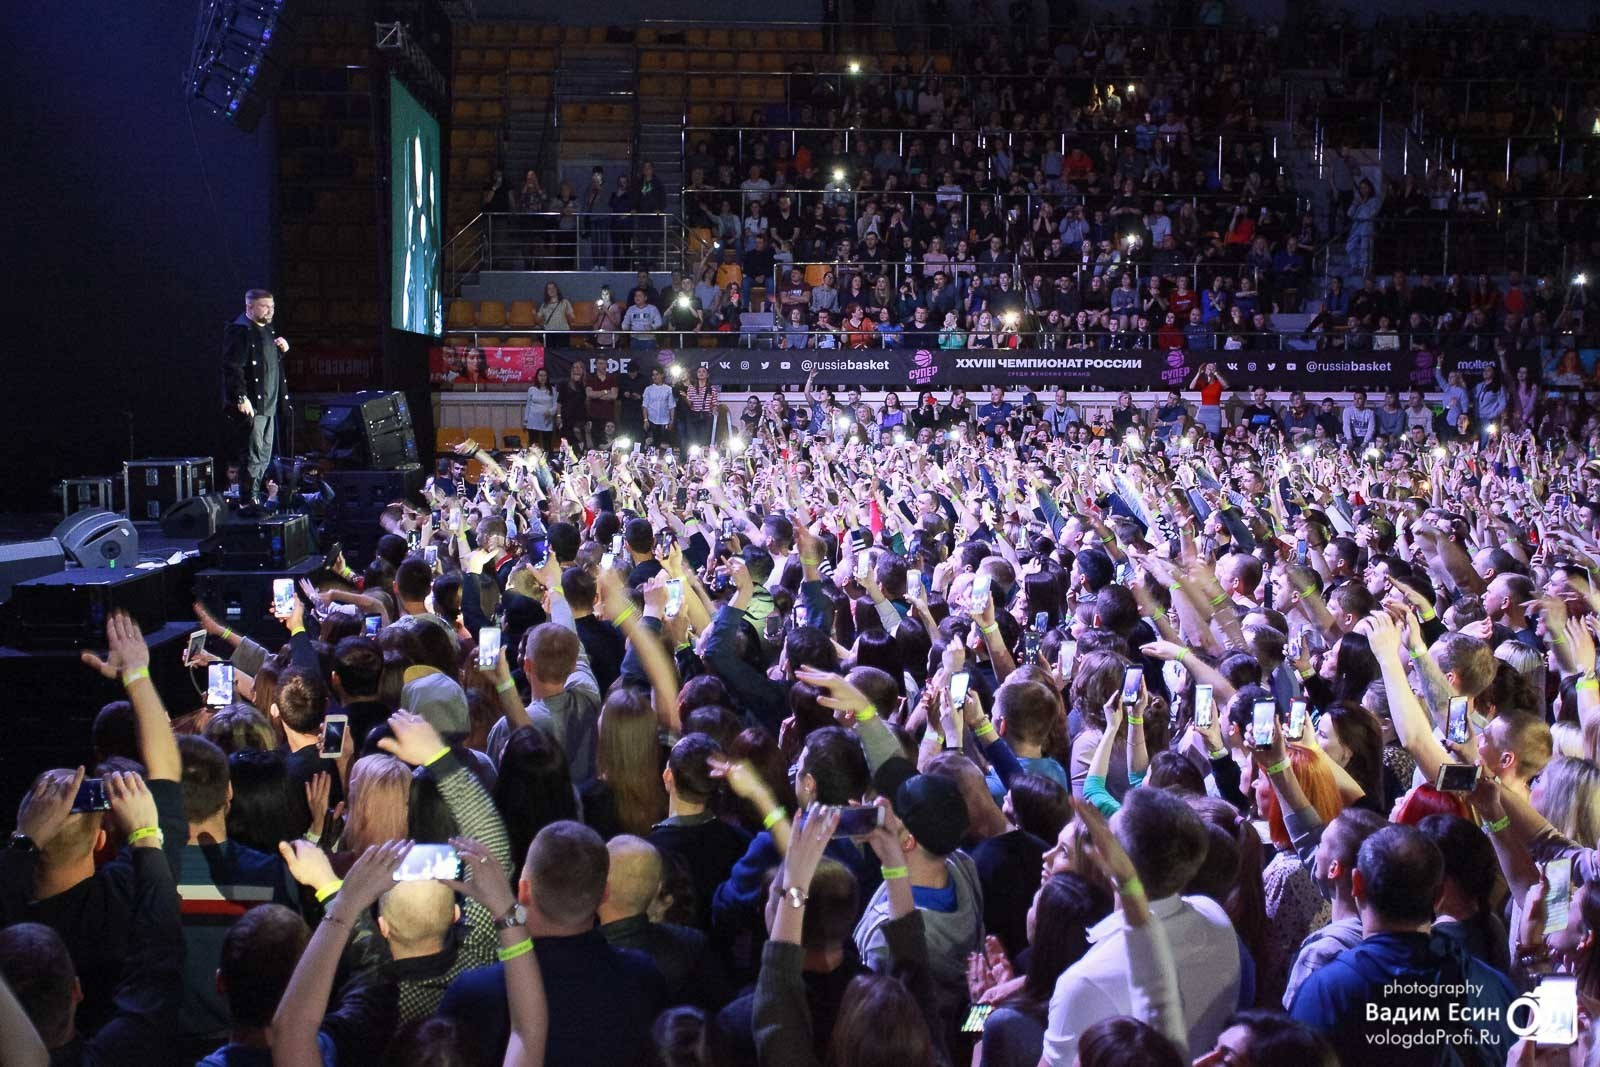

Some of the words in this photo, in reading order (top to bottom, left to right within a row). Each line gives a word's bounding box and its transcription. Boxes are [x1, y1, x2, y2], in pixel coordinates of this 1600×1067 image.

[800, 359, 890, 372] @russiabasket
[955, 358, 996, 369] XXVIII
[998, 358, 1083, 369] ЧЕМПИОНАТ
[1084, 358, 1142, 369] РОССИИ
[1306, 360, 1392, 373] @russiabasket
[908, 366, 938, 380] СУПЕР
[1161, 367, 1190, 380] СУПЕР
